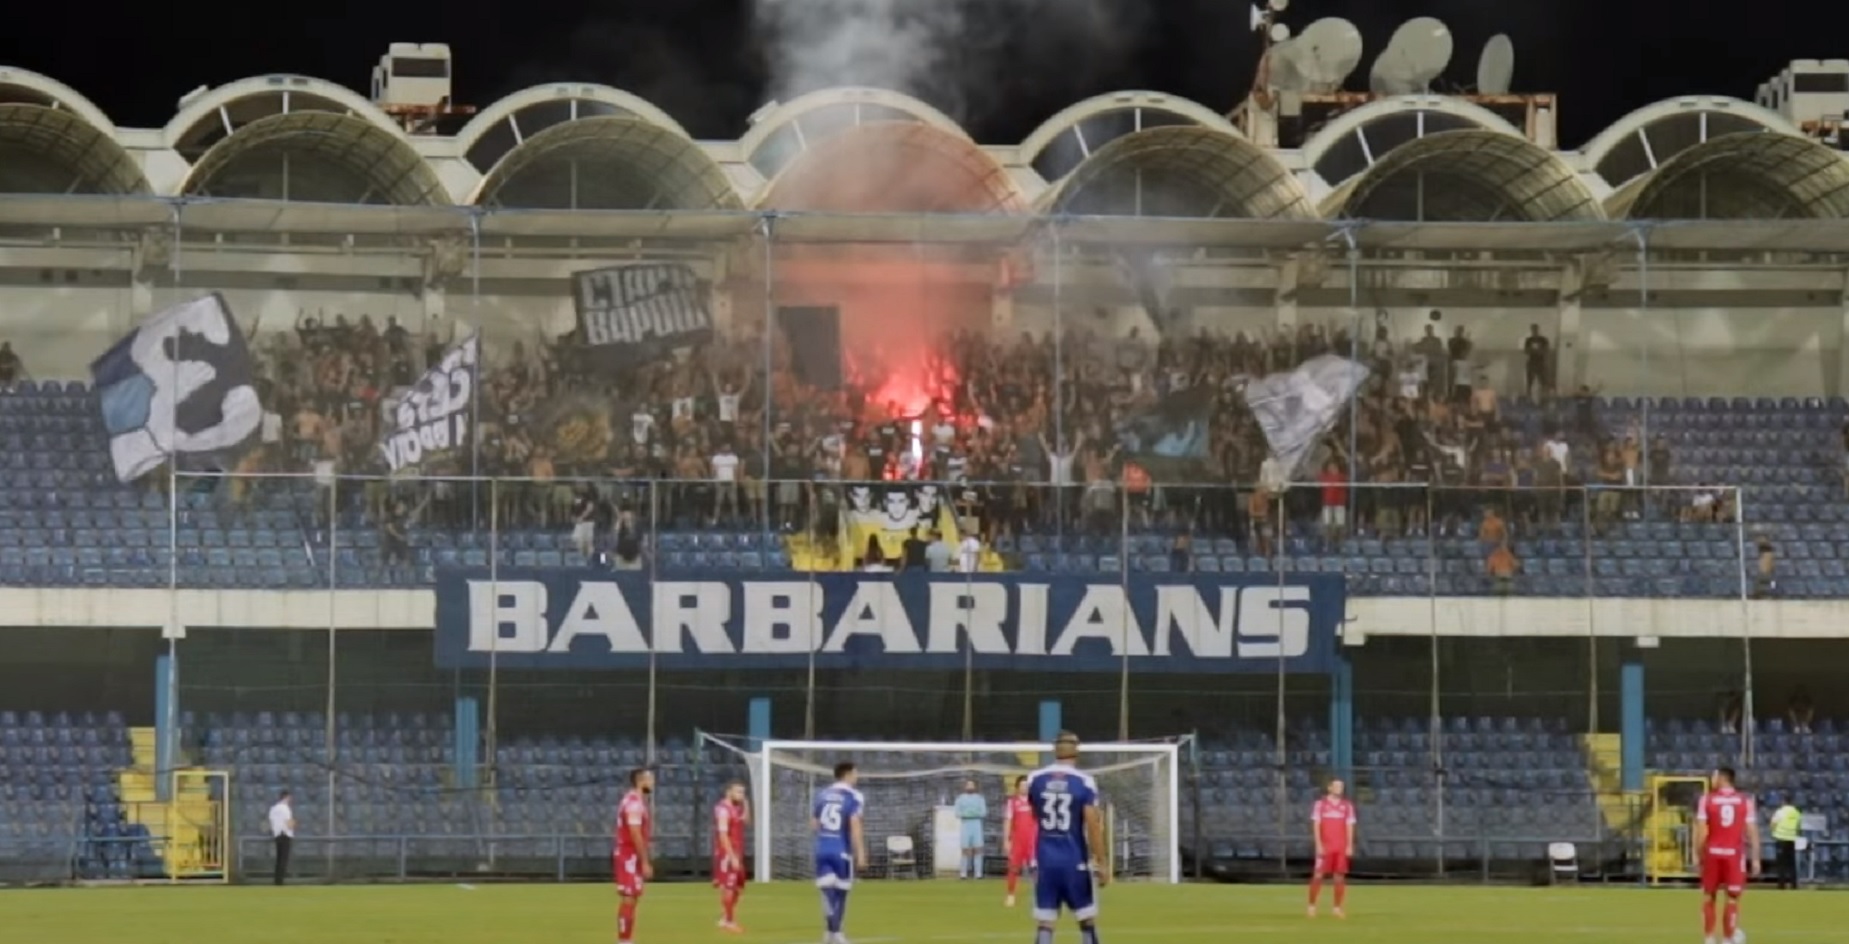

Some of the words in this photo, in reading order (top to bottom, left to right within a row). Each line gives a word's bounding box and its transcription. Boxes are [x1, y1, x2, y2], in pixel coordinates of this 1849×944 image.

[467, 579, 1311, 658] BARBARIANS
[820, 803, 842, 831] 45
[1041, 792, 1072, 831] 33
[1720, 804, 1735, 828] 9
